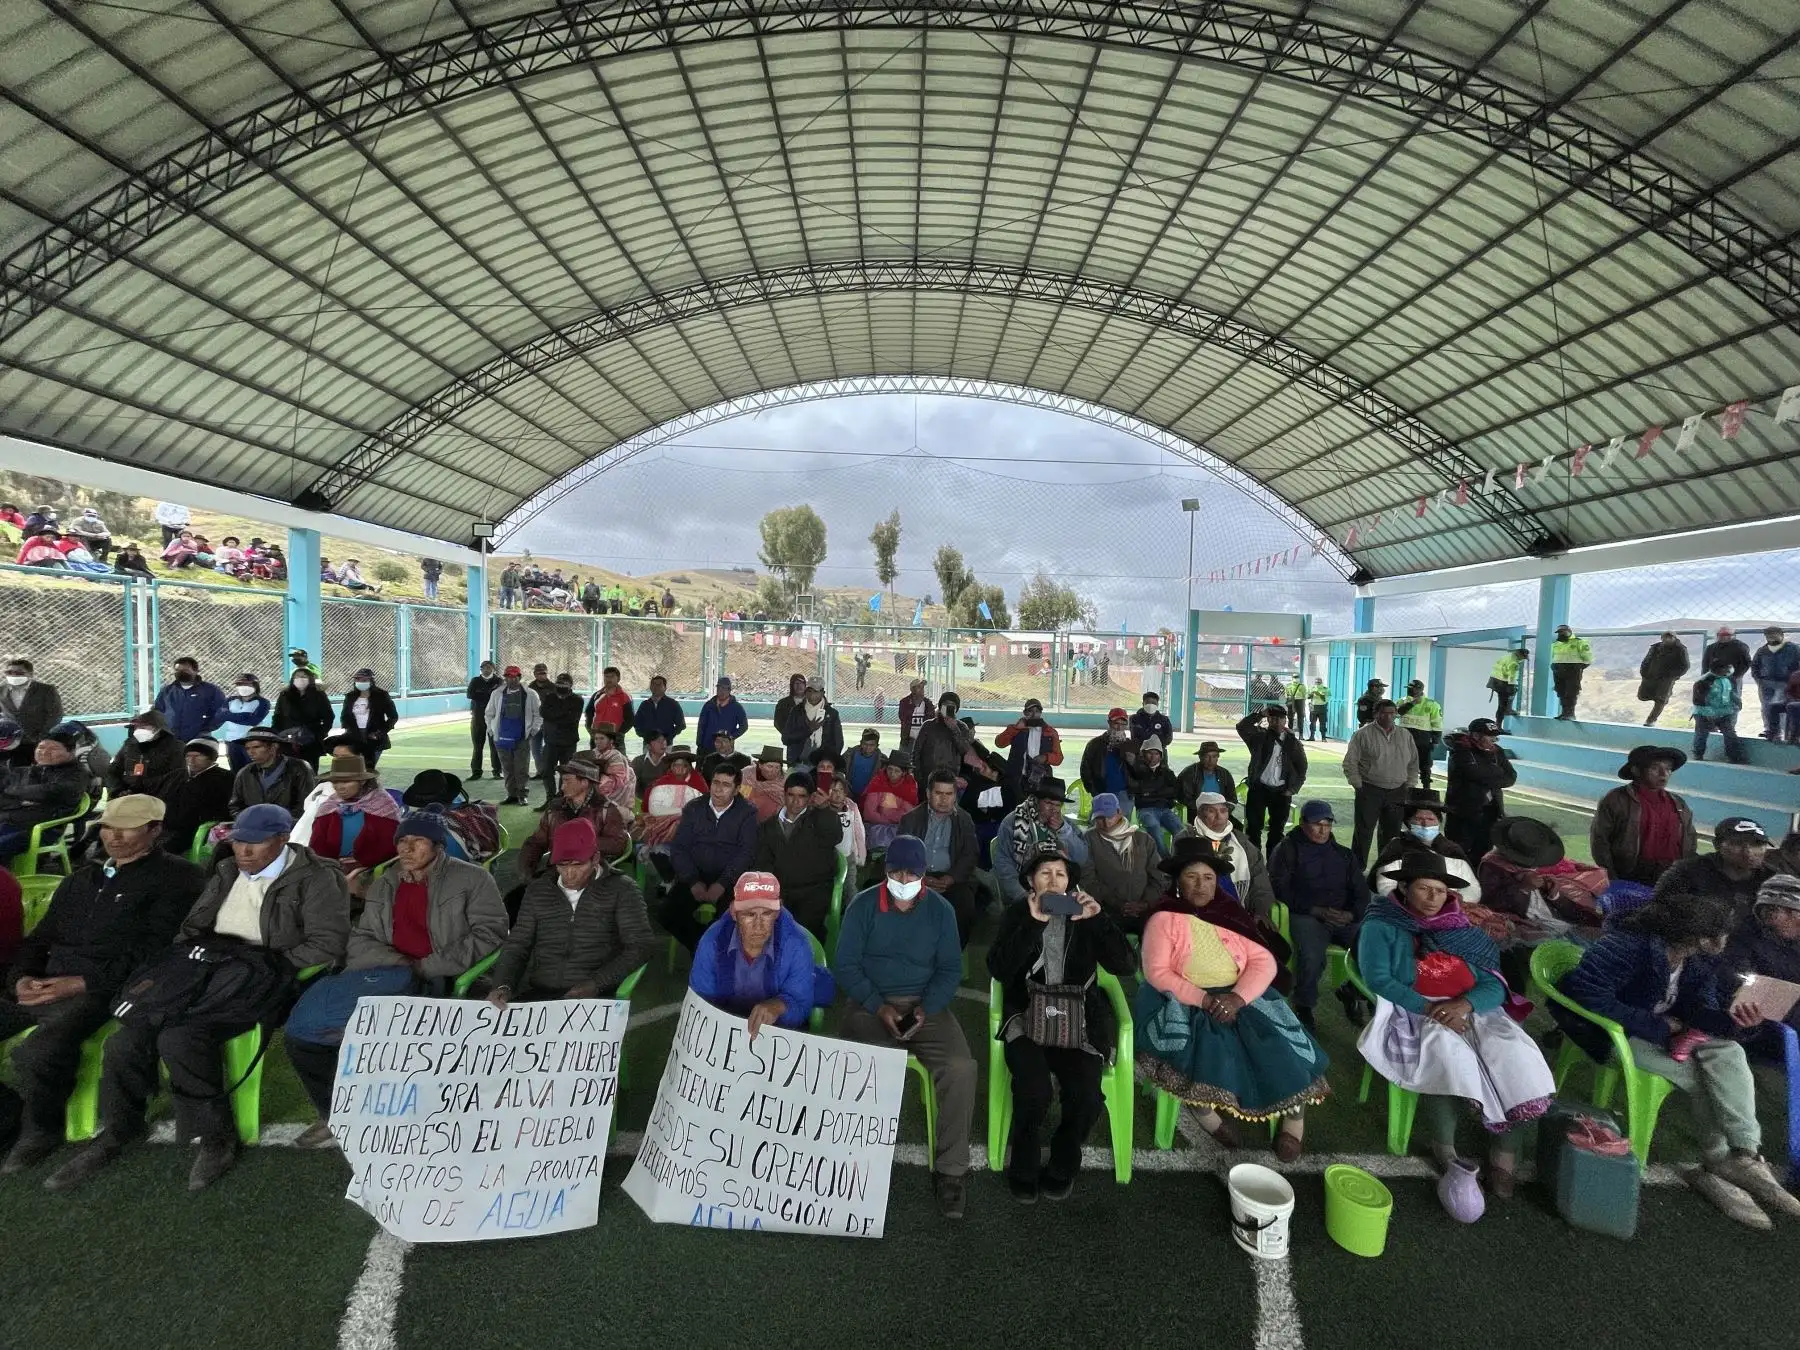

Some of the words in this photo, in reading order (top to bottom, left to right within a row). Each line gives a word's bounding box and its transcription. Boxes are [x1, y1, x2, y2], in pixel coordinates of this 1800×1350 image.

[355, 1004, 380, 1036] EN
[387, 1002, 463, 1036] PLENO
[461, 1005, 547, 1049] SIGLO
[556, 1041, 620, 1073] MUERE
[332, 1085, 358, 1114] DE
[360, 1082, 418, 1117] AGUA
[493, 1077, 555, 1110] ALVA
[569, 1076, 618, 1108] PDTA
[358, 1121, 462, 1161] CONGRESO
[471, 1118, 502, 1153] EL
[514, 1115, 595, 1149] PUEBLO
[652, 1093, 701, 1159] DESDE
[696, 1128, 744, 1171] SU
[739, 1090, 807, 1139] AGUA
[813, 1108, 899, 1148] POTABLE
[380, 1162, 463, 1193] GRITOS
[478, 1163, 505, 1190] LA
[524, 1154, 599, 1187] PRONTA
[422, 1198, 465, 1227] DE
[845, 1212, 875, 1236] DE
